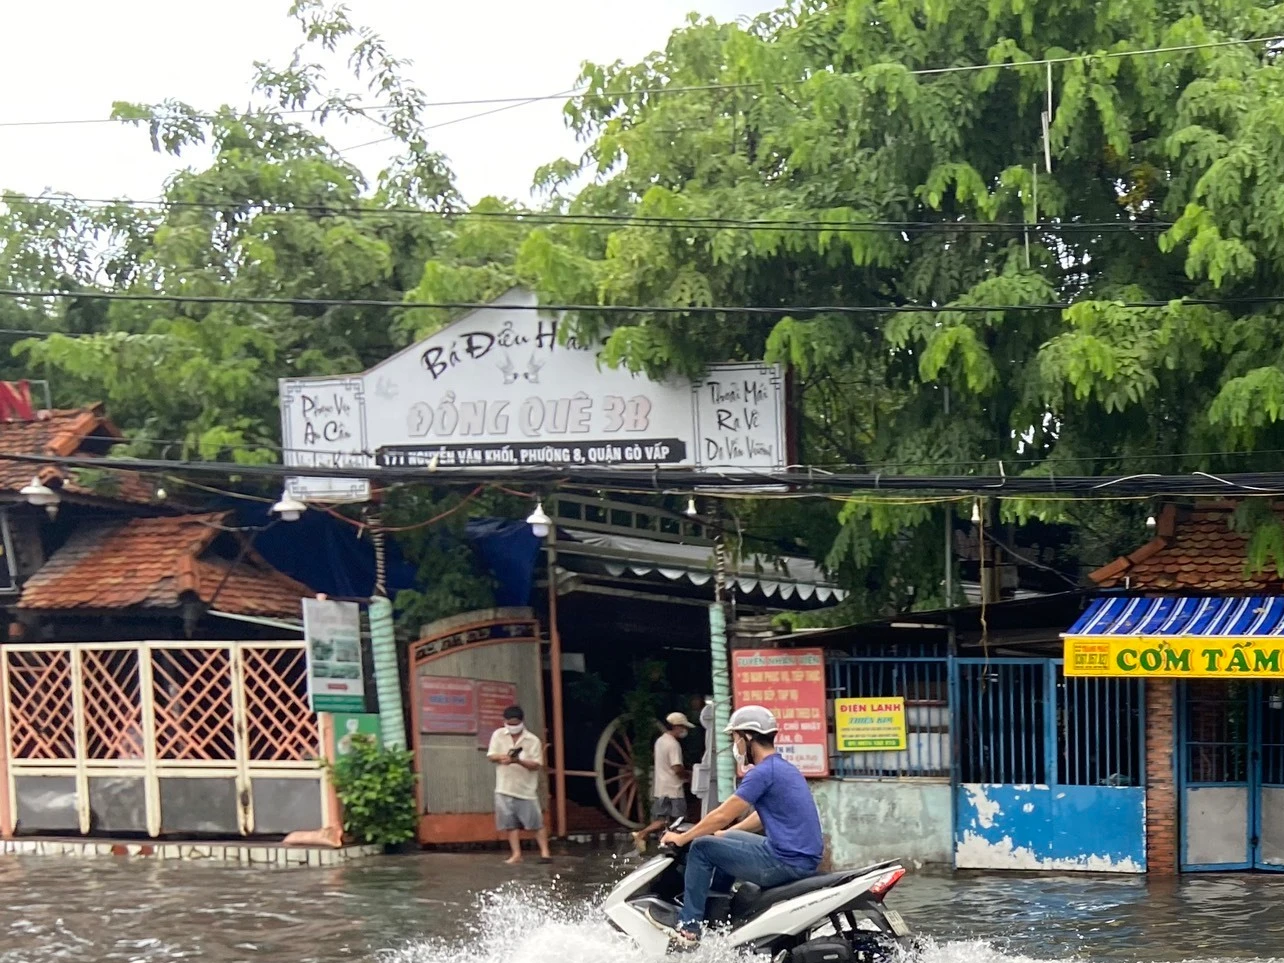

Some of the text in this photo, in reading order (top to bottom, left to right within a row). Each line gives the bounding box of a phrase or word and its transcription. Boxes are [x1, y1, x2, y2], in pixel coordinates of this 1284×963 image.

[407, 390, 651, 438] ĐỒNG QUÊ 3B
[457, 447, 482, 464] VĂN
[520, 445, 571, 463] PHƯỜNG
[573, 447, 585, 463] 8,
[588, 444, 622, 463] QUẬN
[624, 443, 643, 460] GÒ
[644, 441, 670, 460] VẤP
[1116, 640, 1191, 672] CƠM
[1201, 641, 1281, 672] TẤM
